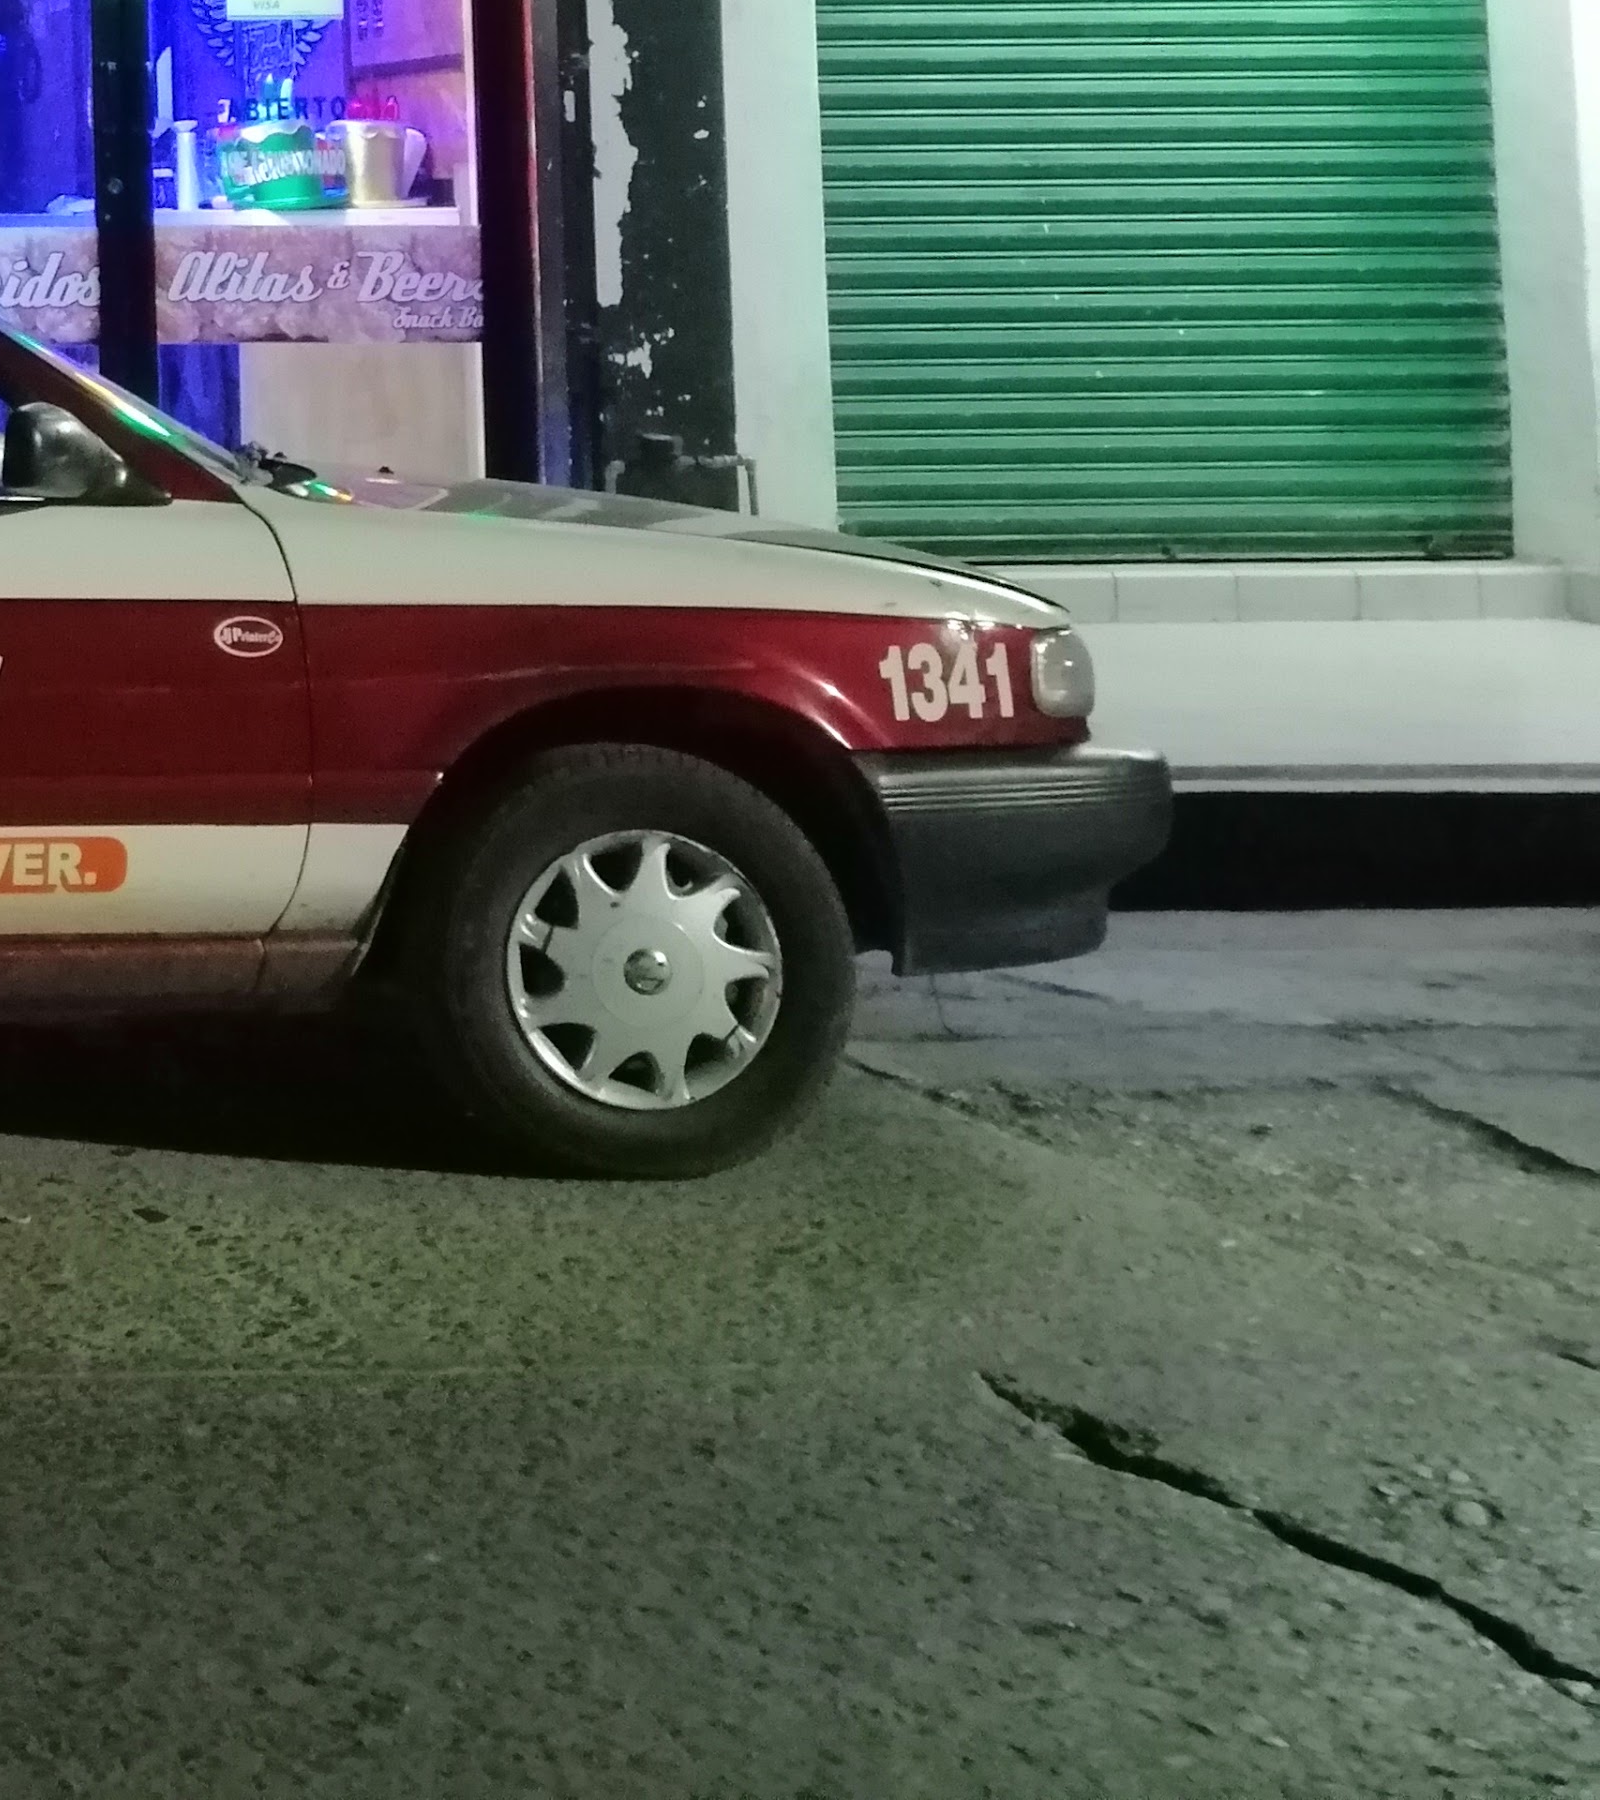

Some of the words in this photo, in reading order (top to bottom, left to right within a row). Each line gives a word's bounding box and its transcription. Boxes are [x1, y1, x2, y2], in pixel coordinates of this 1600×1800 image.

[252, 0, 281, 11] VISA
[168, 250, 323, 304] Alitas
[327, 260, 351, 290] &
[393, 305, 453, 329] Snack
[457, 305, 485, 329] Ba
[878, 642, 1015, 722] 1341
